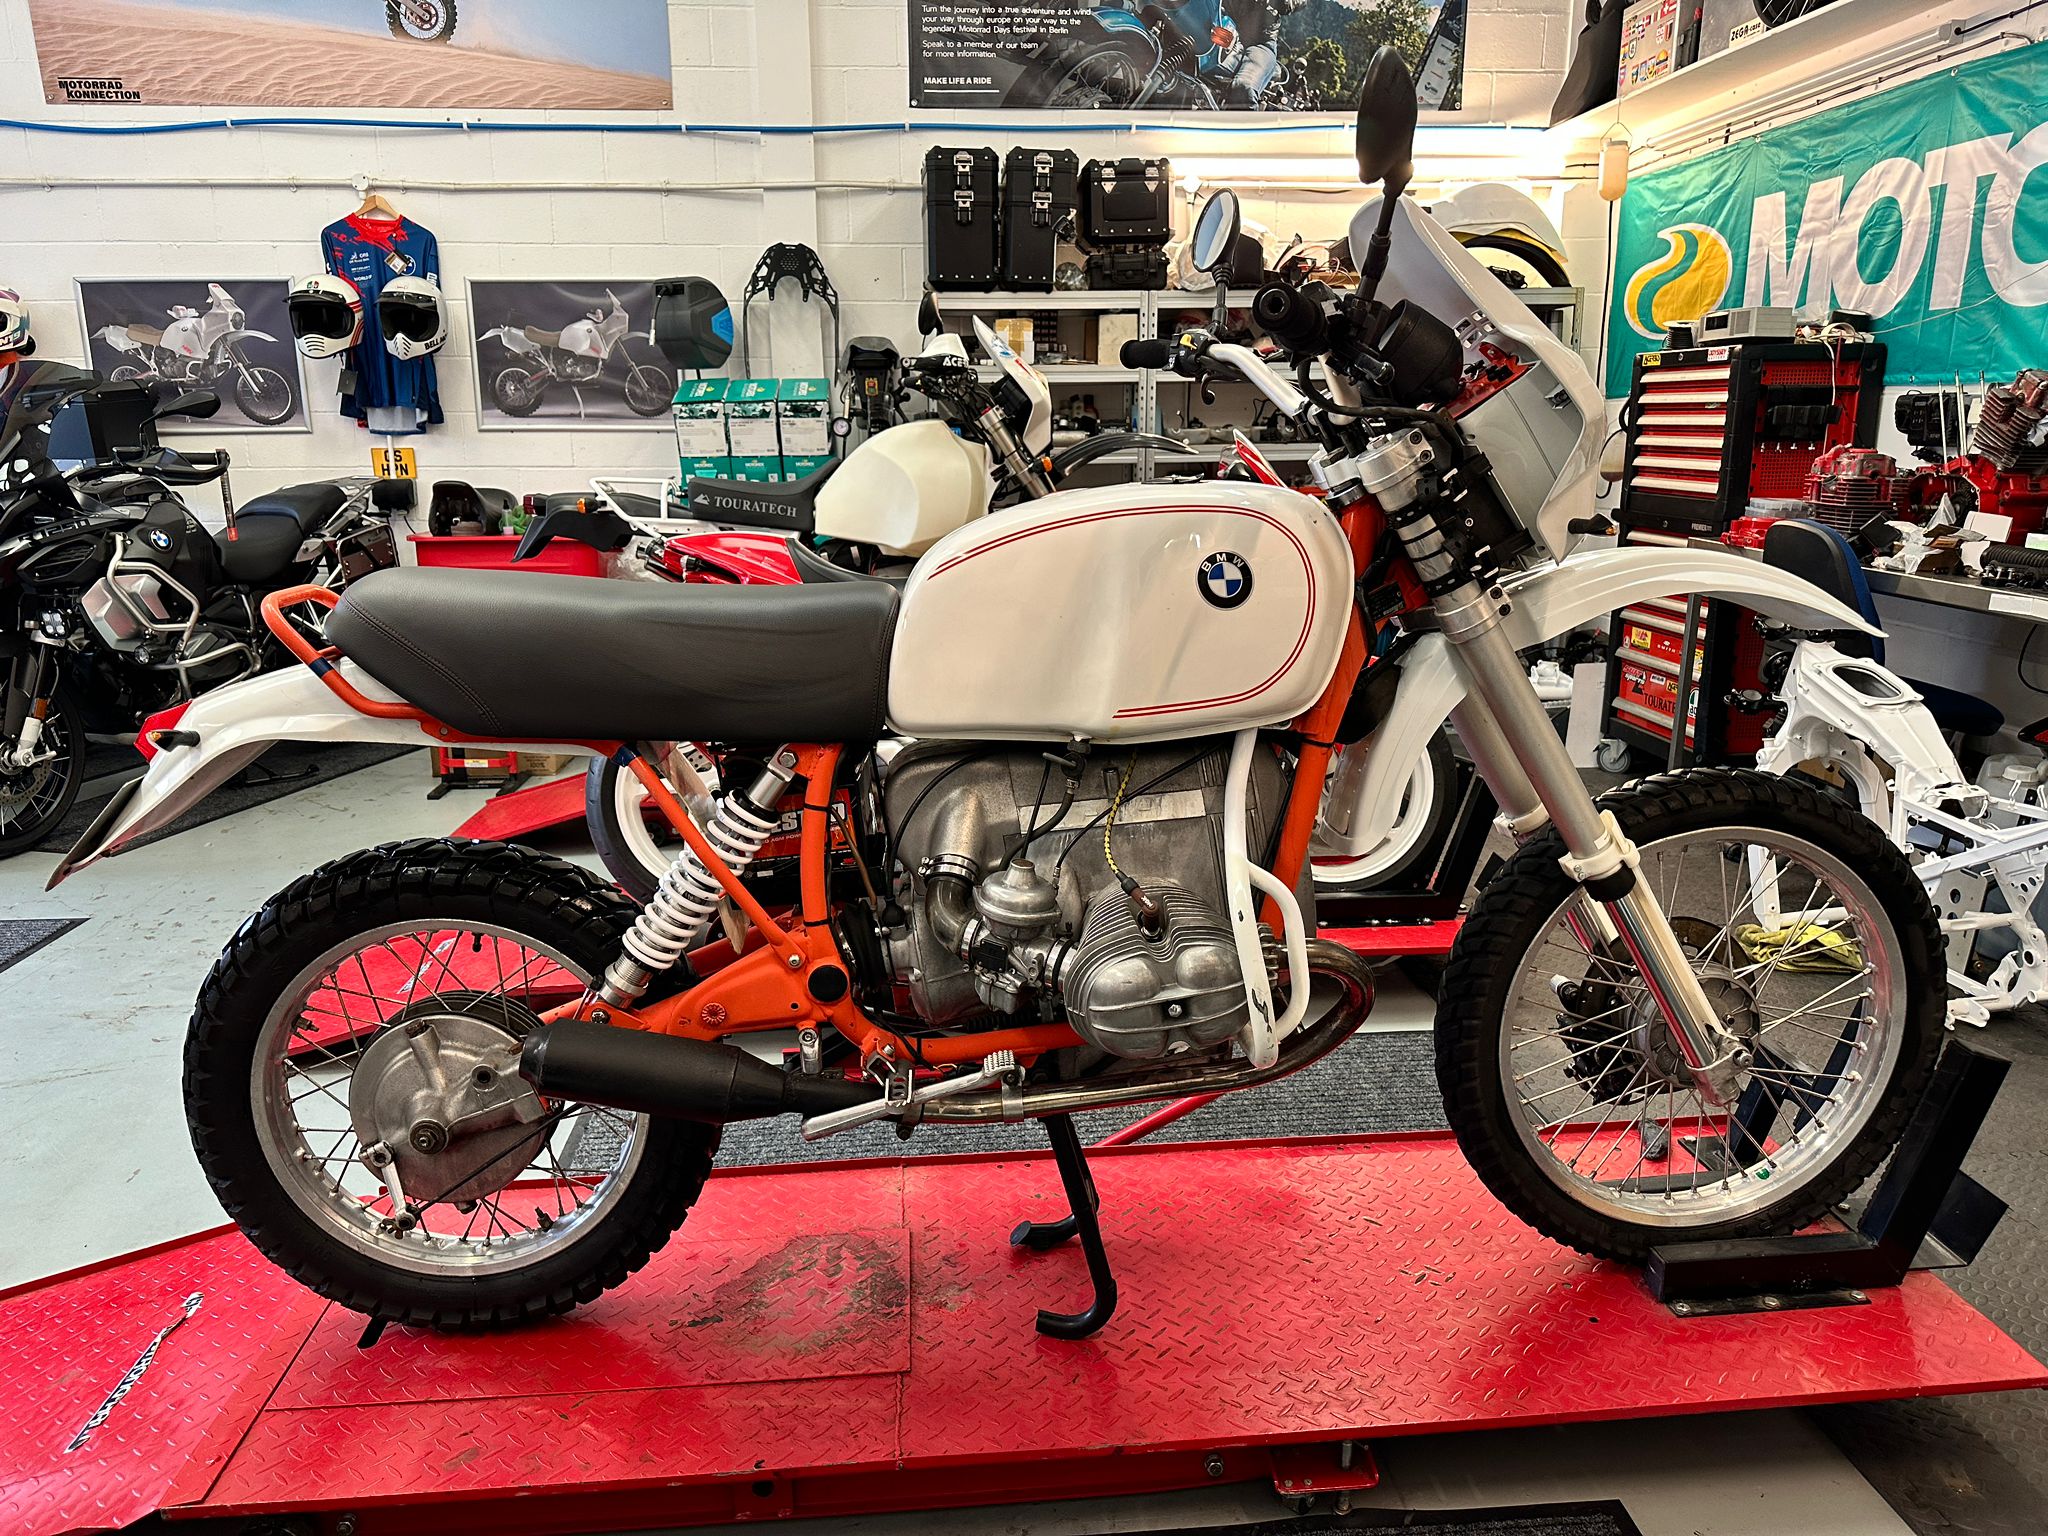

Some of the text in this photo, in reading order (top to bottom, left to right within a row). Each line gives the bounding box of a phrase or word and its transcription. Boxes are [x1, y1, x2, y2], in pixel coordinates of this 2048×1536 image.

[922, 5, 937, 13] Turn
[940, 5, 951, 13] the
[954, 6, 979, 15] journey
[982, 6, 995, 14] into
[1021, 7, 1055, 15] adventure
[1057, 7, 1071, 15] and
[1073, 8, 1091, 16] wind
[922, 16, 937, 24] your
[957, 15, 984, 24] through
[986, 17, 1011, 25] europe
[1025, 17, 1040, 25] your
[1042, 18, 1058, 26] way
[1069, 17, 1081, 25] the
[922, 25, 956, 33] legendary
[959, 25, 991, 33] Motorrad
[993, 26, 1011, 34] Days
[1012, 25, 1038, 33] festival
[922, 40, 944, 49] Speak
[964, 41, 994, 49] member
[957, 50, 997, 58] information
[58, 80, 123, 89] MOTORRAD
[66, 90, 141, 100] KONNECTION
[424, 340, 440, 351] BELL
[714, 496, 797, 517] TOURATECH
[1201, 553, 1244, 572] BMW
